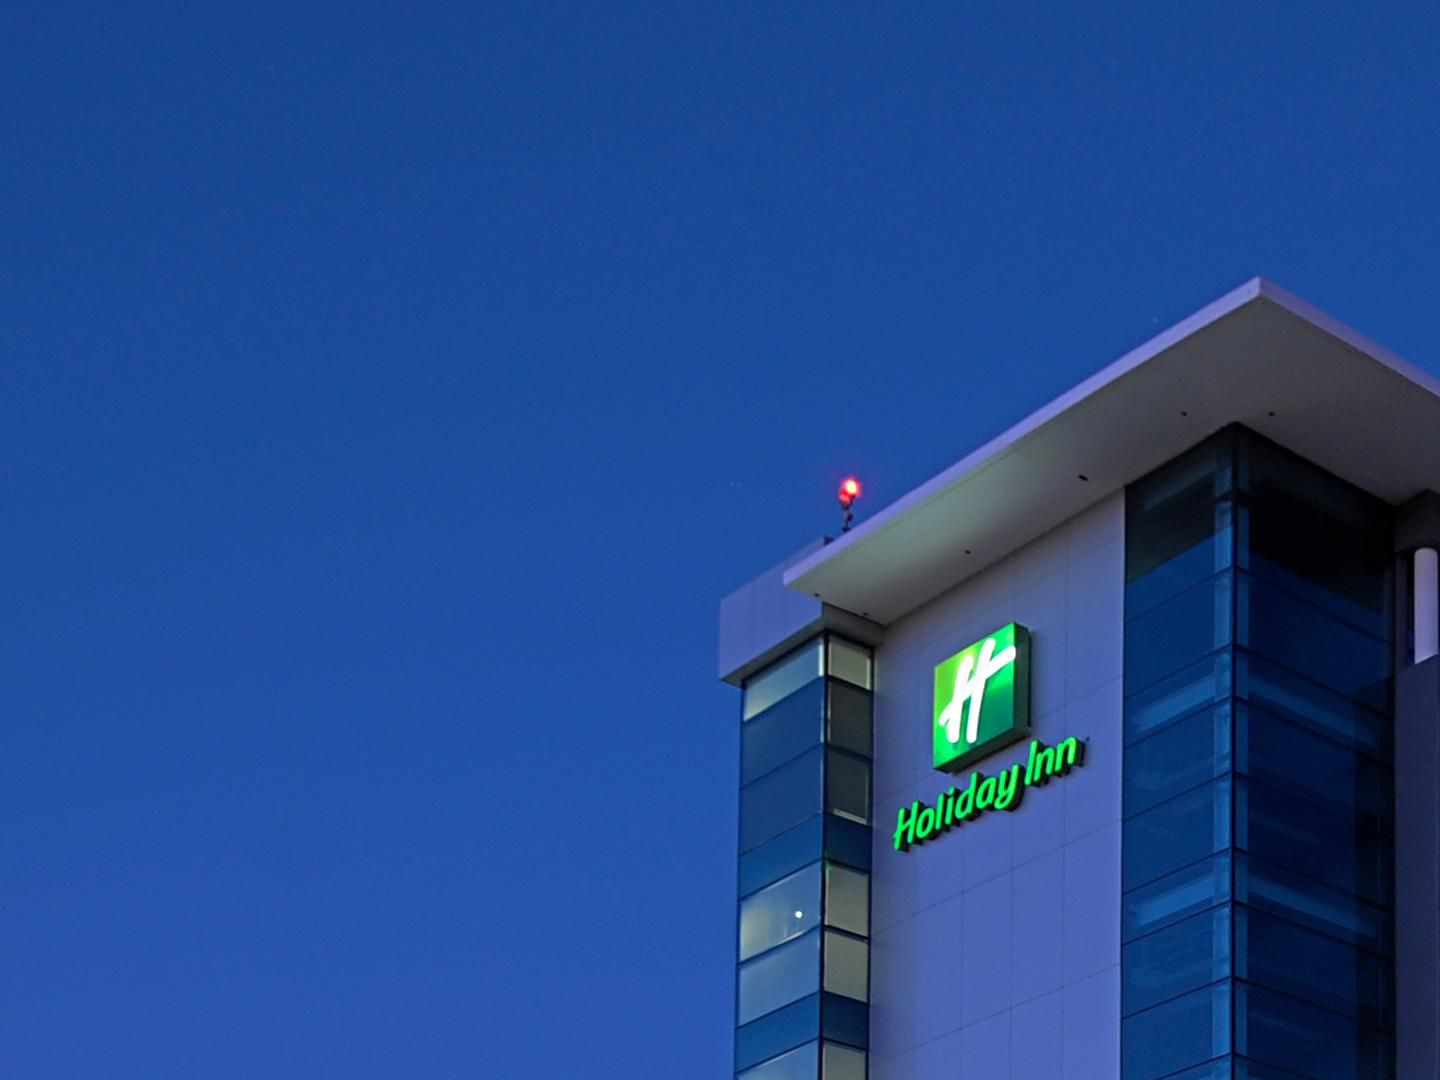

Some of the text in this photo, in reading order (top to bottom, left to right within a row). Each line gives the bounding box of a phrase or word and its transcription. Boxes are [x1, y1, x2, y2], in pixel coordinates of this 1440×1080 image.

[938, 637, 1016, 744] H
[893, 736, 1079, 851] Holiday Inn
